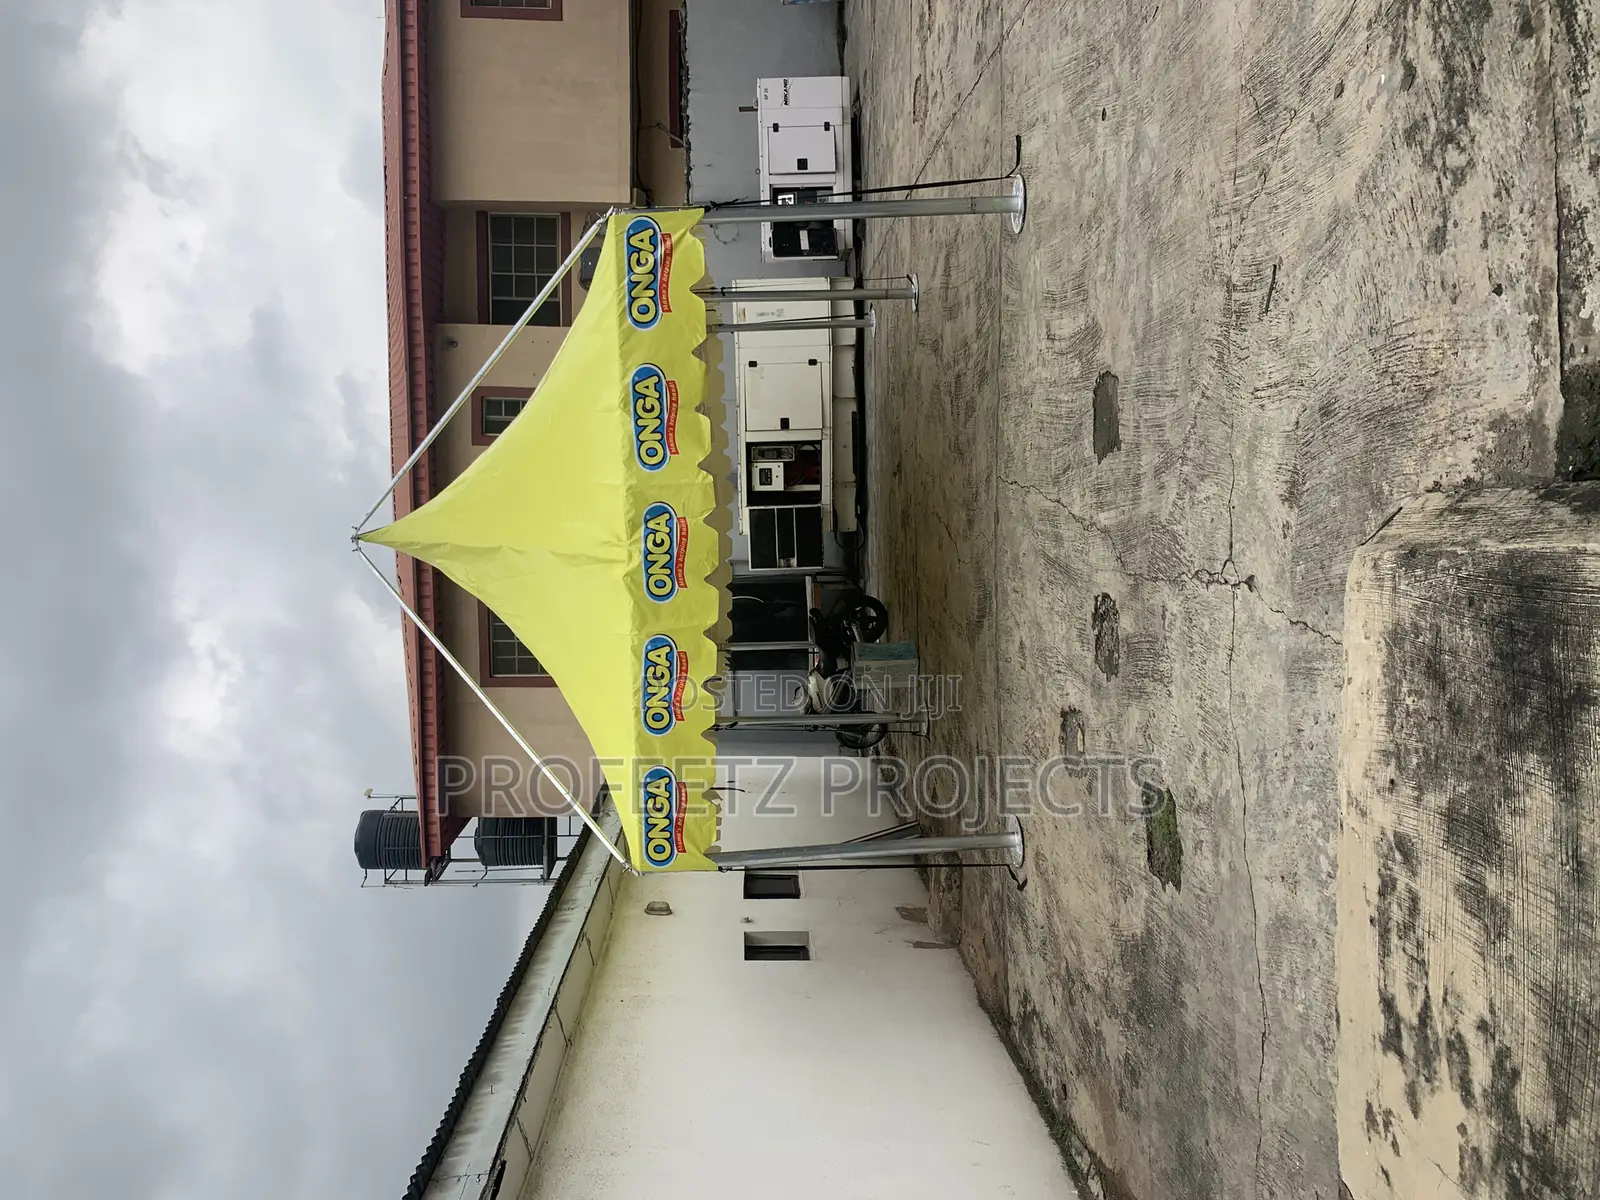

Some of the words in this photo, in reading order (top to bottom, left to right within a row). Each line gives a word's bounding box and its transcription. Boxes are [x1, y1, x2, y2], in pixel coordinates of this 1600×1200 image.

[662, 234, 672, 254] hand!
[629, 228, 657, 324] ONGA
[663, 256, 672, 281] helping
[661, 284, 669, 311] Mama's
[668, 381, 677, 401] hand!
[634, 374, 665, 466] ONGA
[669, 403, 677, 425] helping
[668, 428, 676, 453] Mama's
[679, 518, 687, 535] hand!
[646, 512, 673, 597] ONGA
[678, 537, 687, 561] helping
[677, 563, 685, 586] Mama's
[679, 652, 687, 670] hand!
[645, 645, 672, 730] ONGA
[675, 671, 686, 697] helping
[646, 776, 672, 862] ONGA
